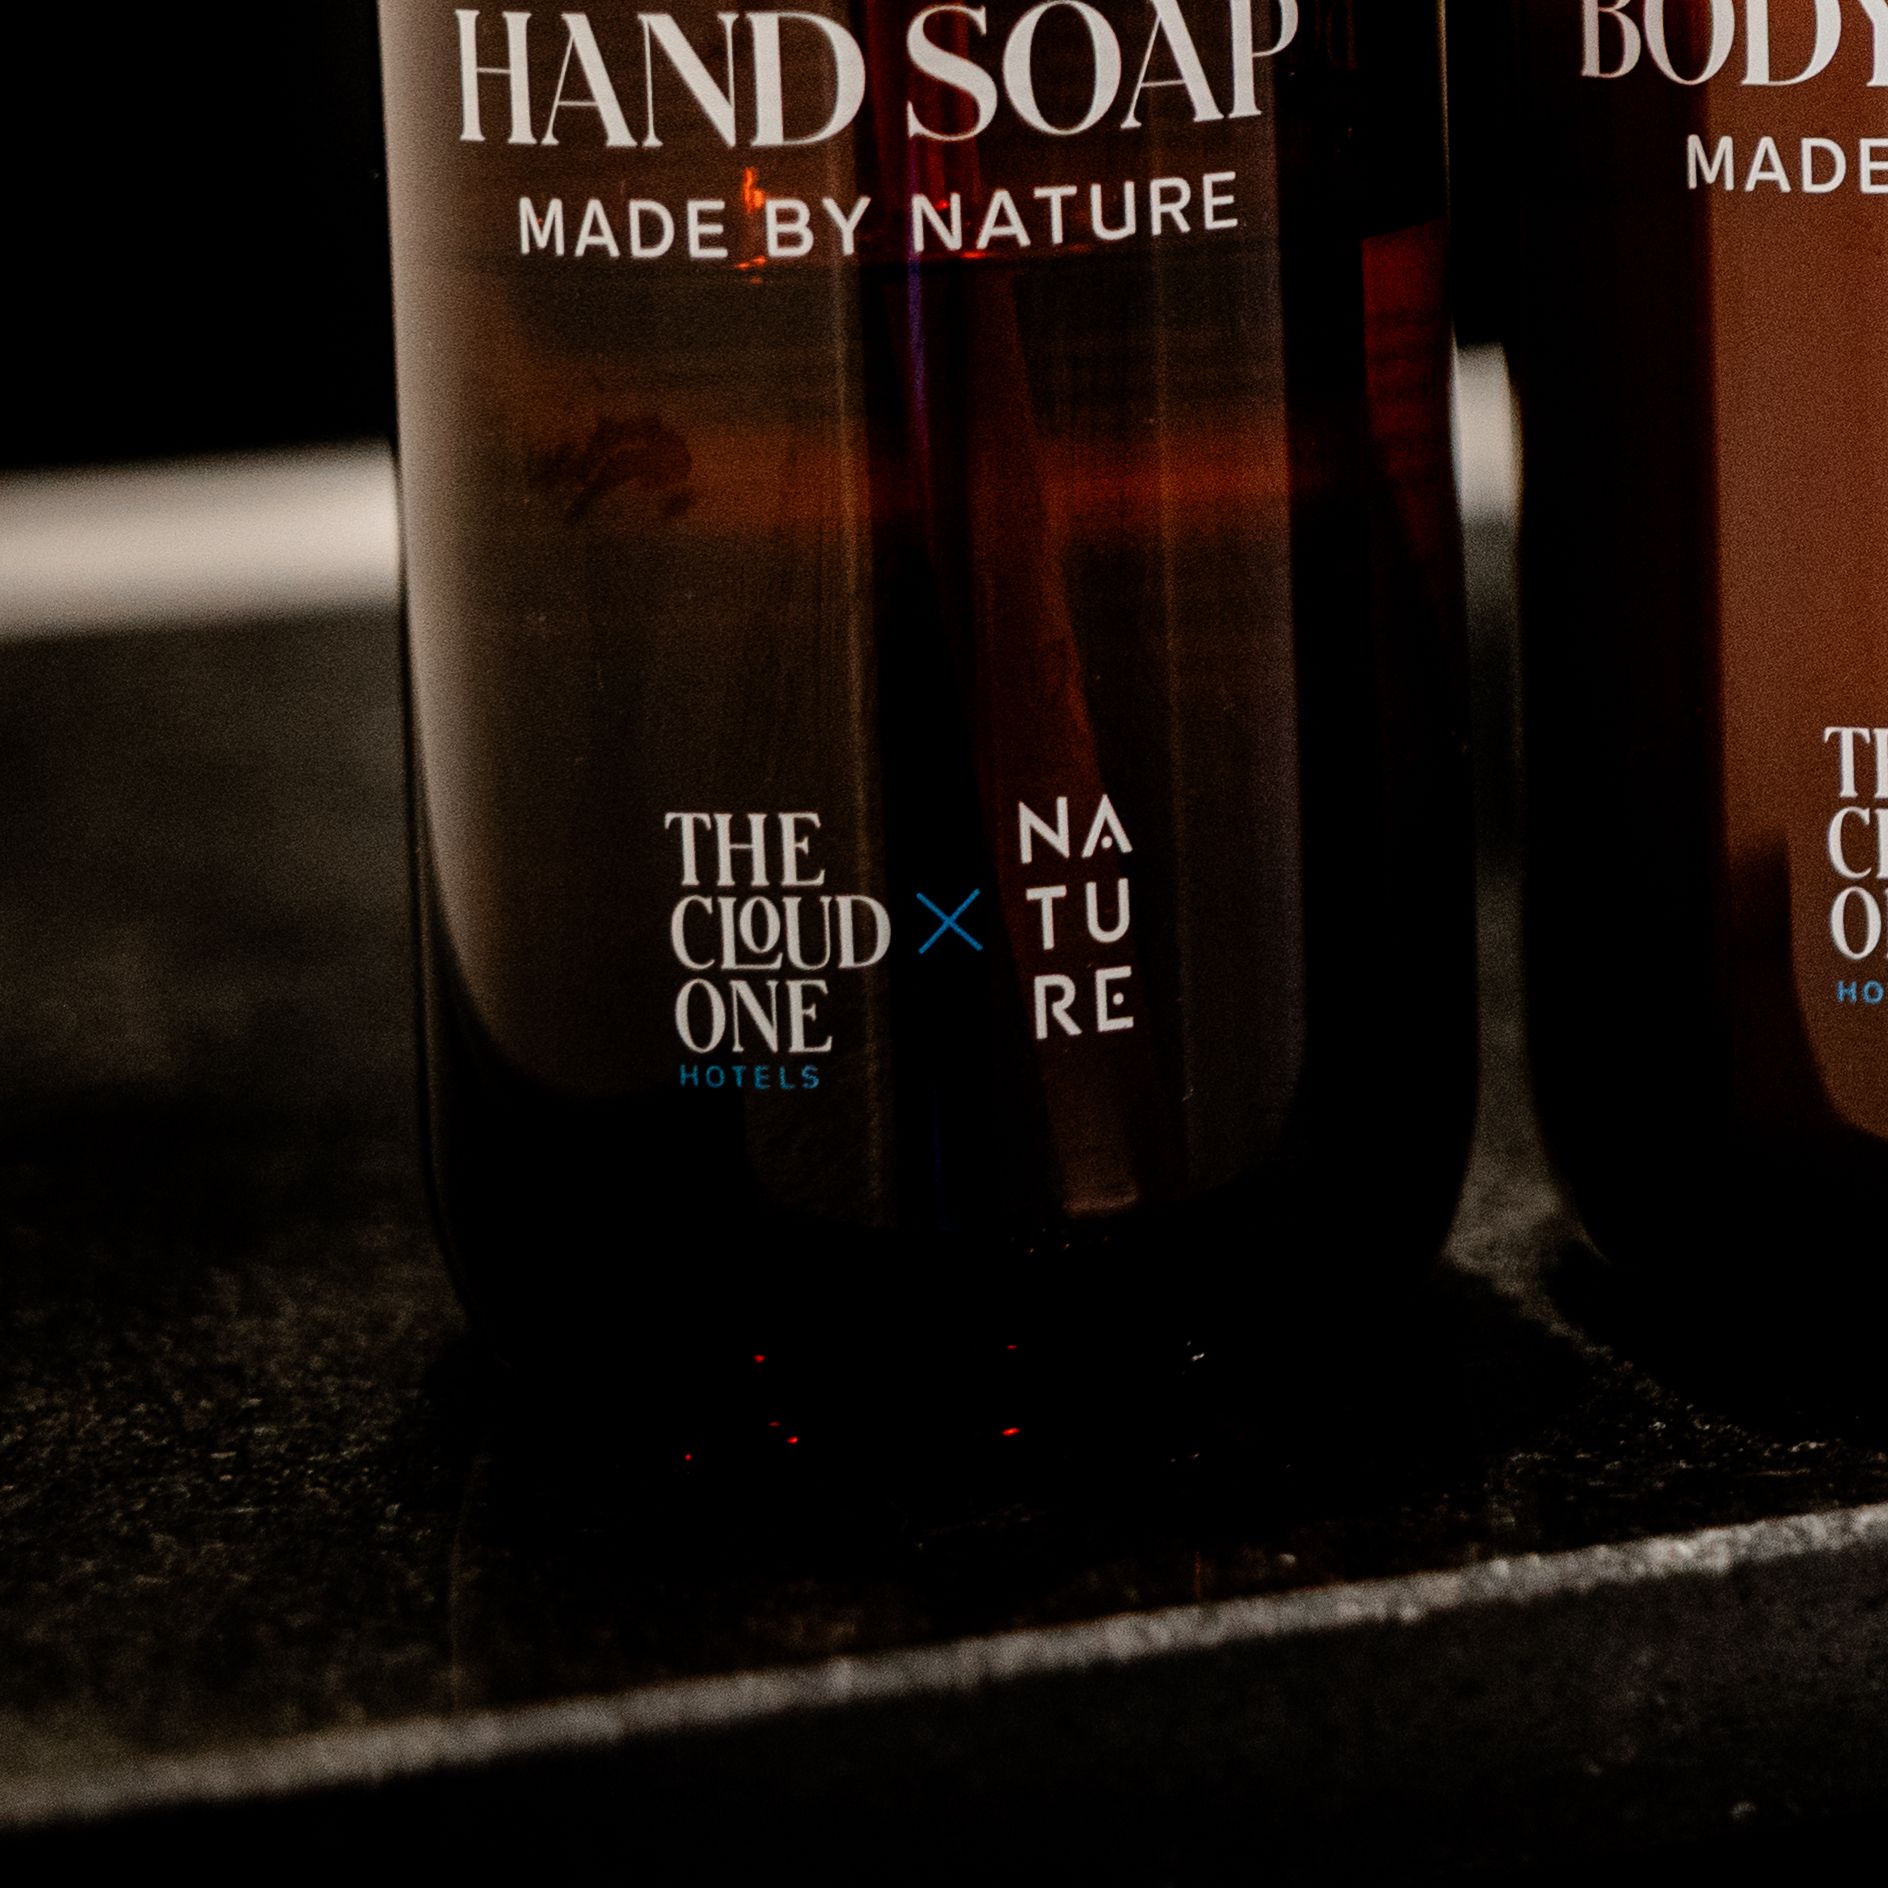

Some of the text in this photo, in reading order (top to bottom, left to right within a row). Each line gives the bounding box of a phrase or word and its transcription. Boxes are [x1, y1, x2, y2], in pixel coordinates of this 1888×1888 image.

[454, 8, 866, 148] HAND
[518, 170, 1239, 259] MADE BY NATURE
[664, 811, 825, 887] THE
[670, 895, 891, 970] CLOUD
[674, 978, 833, 1053] ONE
[679, 1064, 820, 1090] HOTELS
